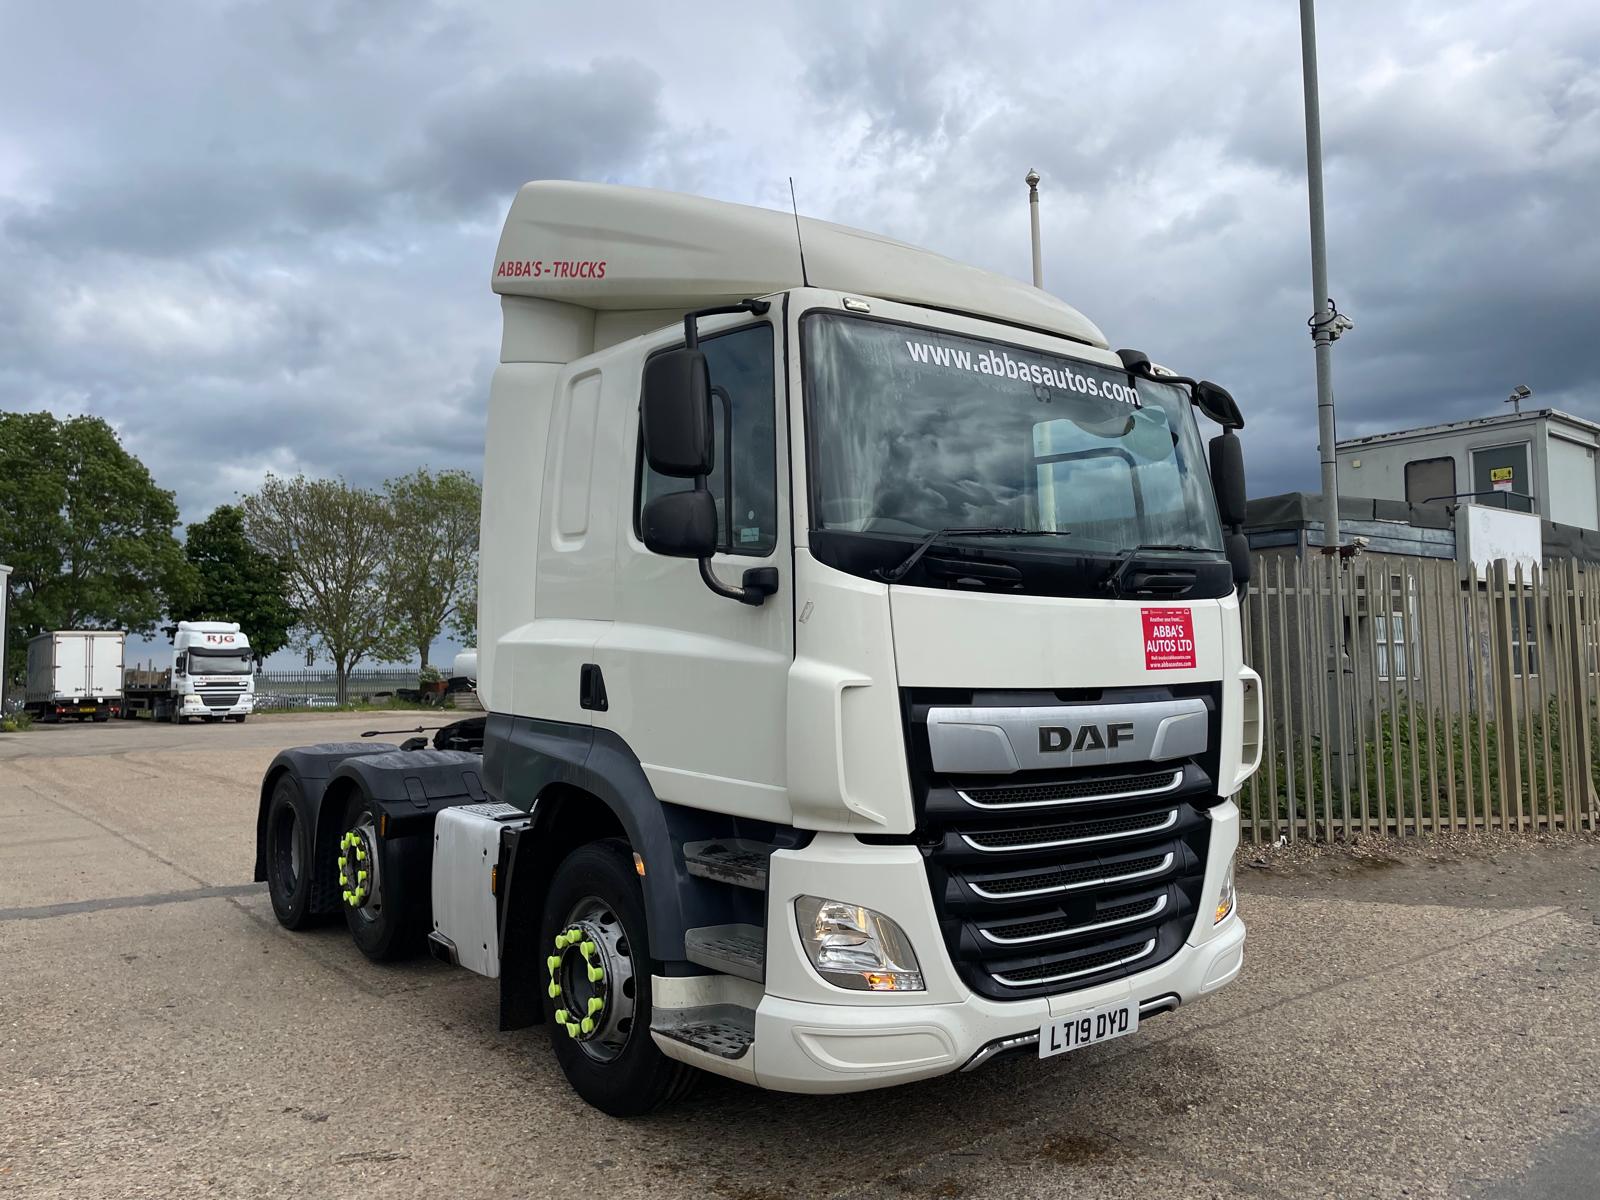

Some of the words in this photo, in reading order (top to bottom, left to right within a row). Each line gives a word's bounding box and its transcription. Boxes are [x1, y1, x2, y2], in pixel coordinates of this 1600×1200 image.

[906, 341, 1142, 406] www.abbasautos.com
[207, 634, 235, 644] RJG
[1153, 625, 1184, 638] ABBA'S
[1147, 640, 1176, 652] AUTOS
[1177, 639, 1192, 652] LTD
[1039, 722, 1134, 753] DAF
[1051, 1018, 1091, 1051] LT19
[1096, 1008, 1129, 1038] DYD
